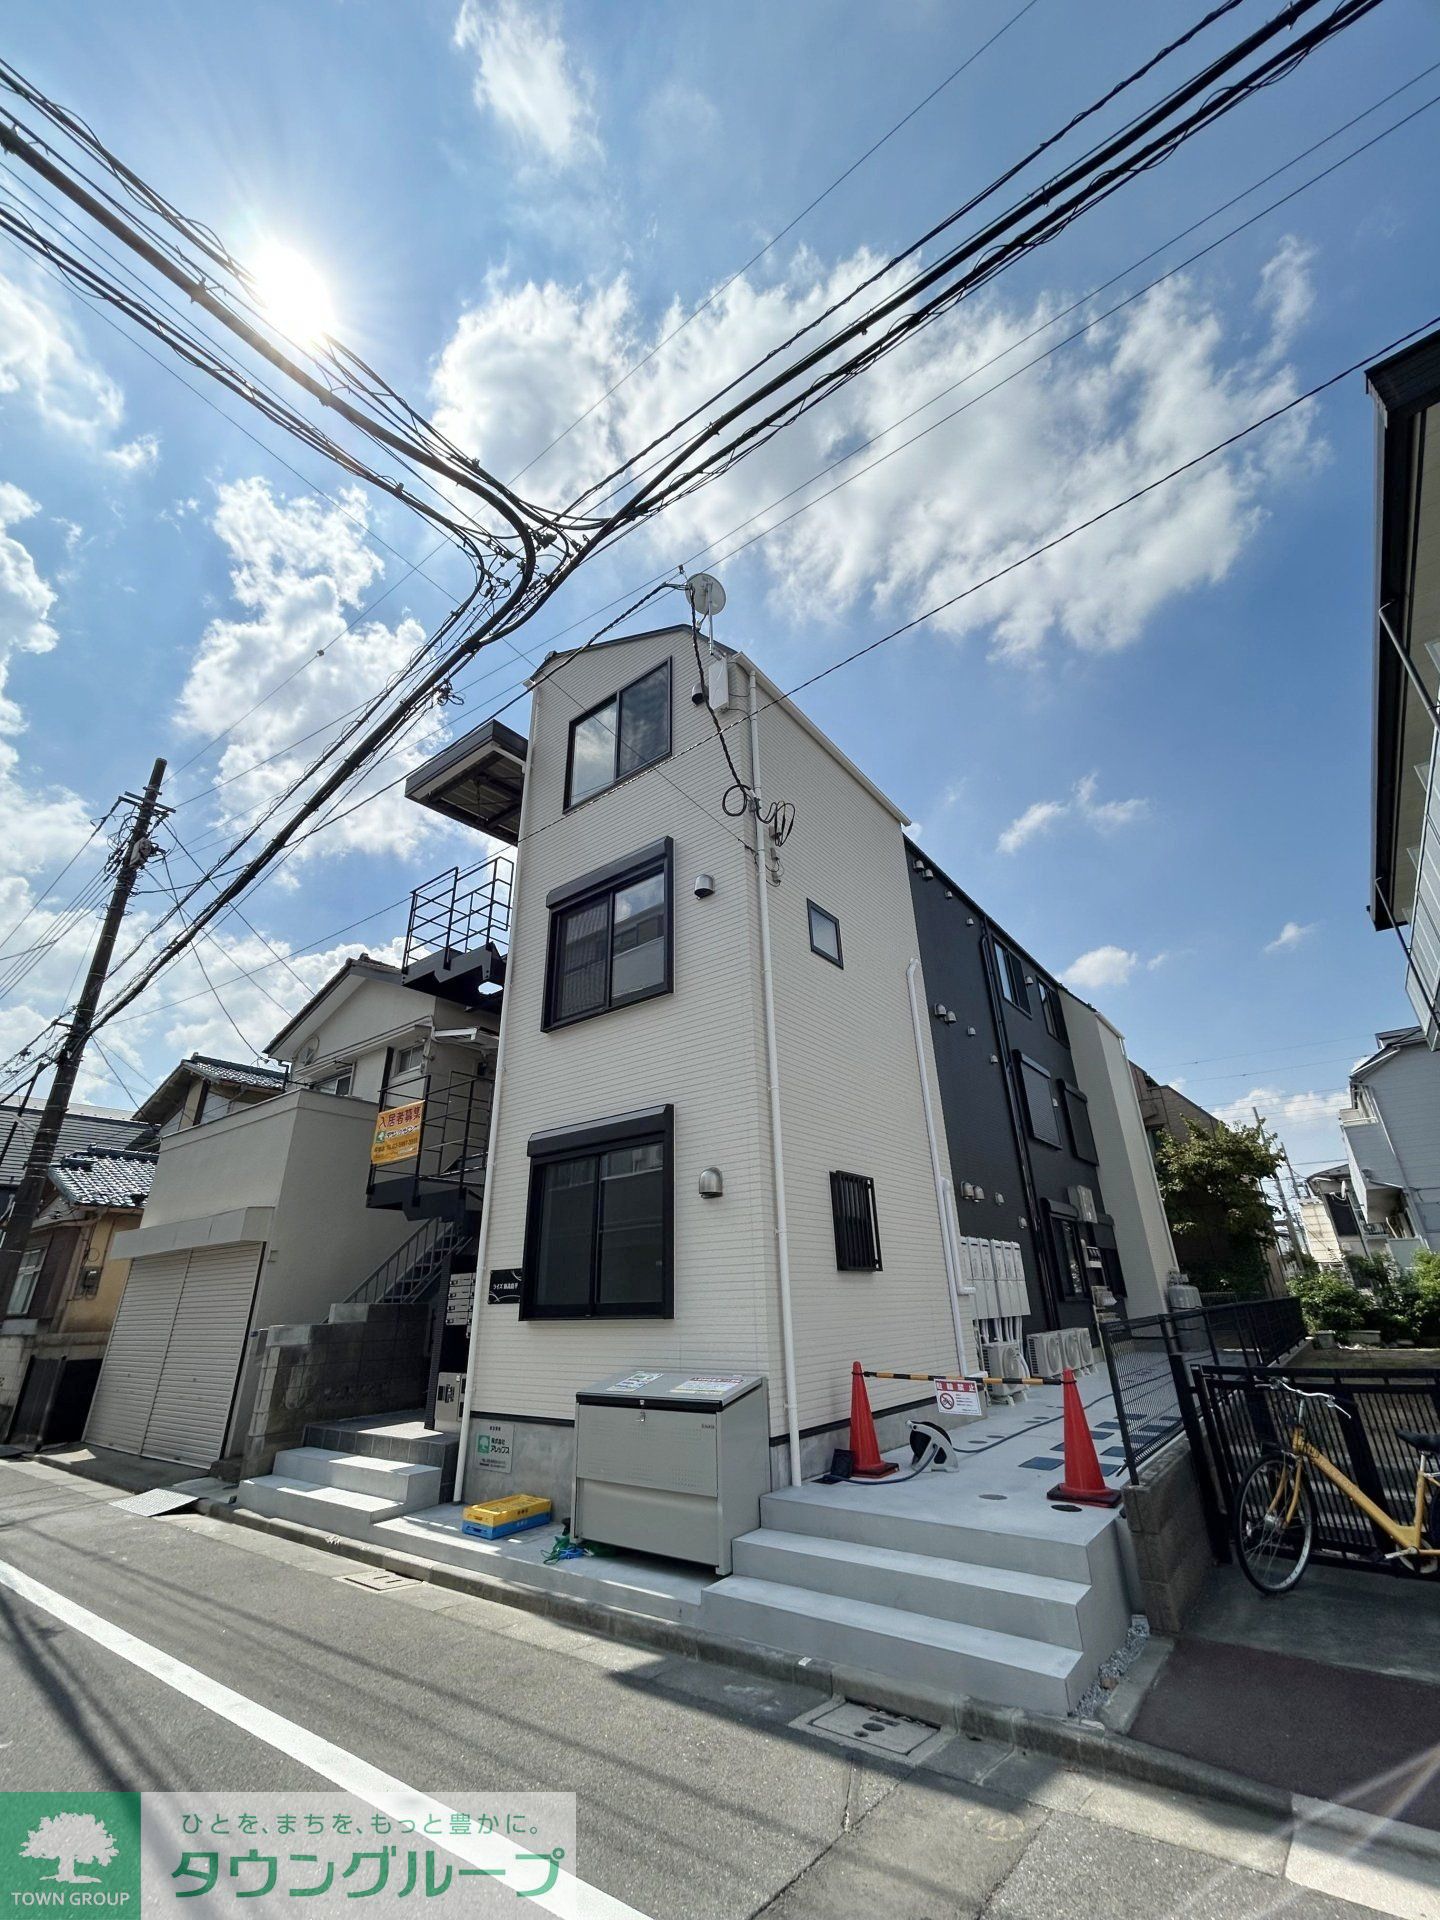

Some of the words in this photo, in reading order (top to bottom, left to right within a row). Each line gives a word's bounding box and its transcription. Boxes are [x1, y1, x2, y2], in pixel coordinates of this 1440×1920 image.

[379, 1106, 421, 1129] 入居者募集
